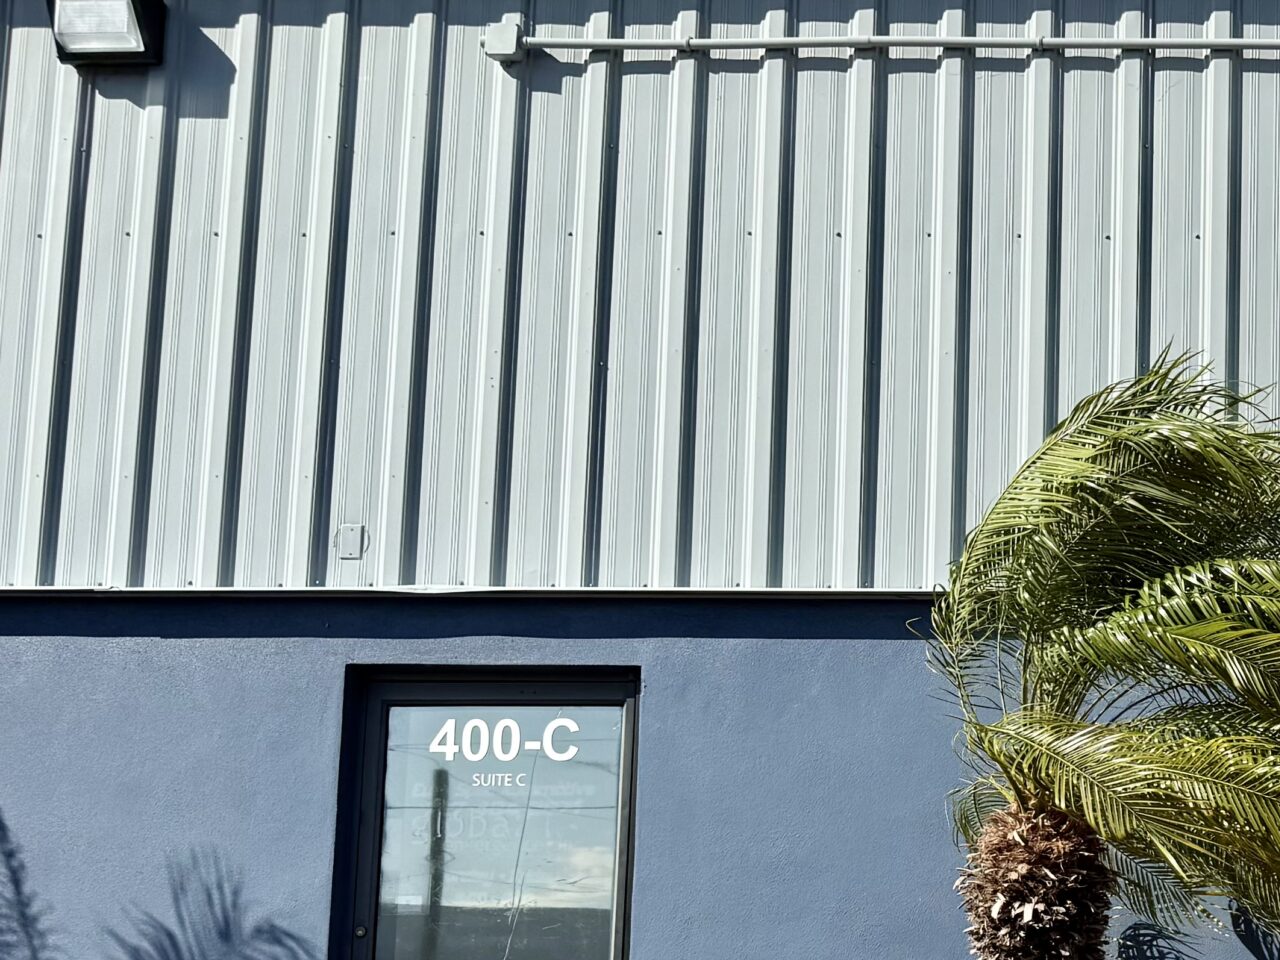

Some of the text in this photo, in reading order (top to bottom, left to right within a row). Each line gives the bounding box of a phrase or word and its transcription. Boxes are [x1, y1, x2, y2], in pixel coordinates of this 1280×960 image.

[429, 717, 580, 762] 400-C
[471, 773, 527, 787] SUITE C
